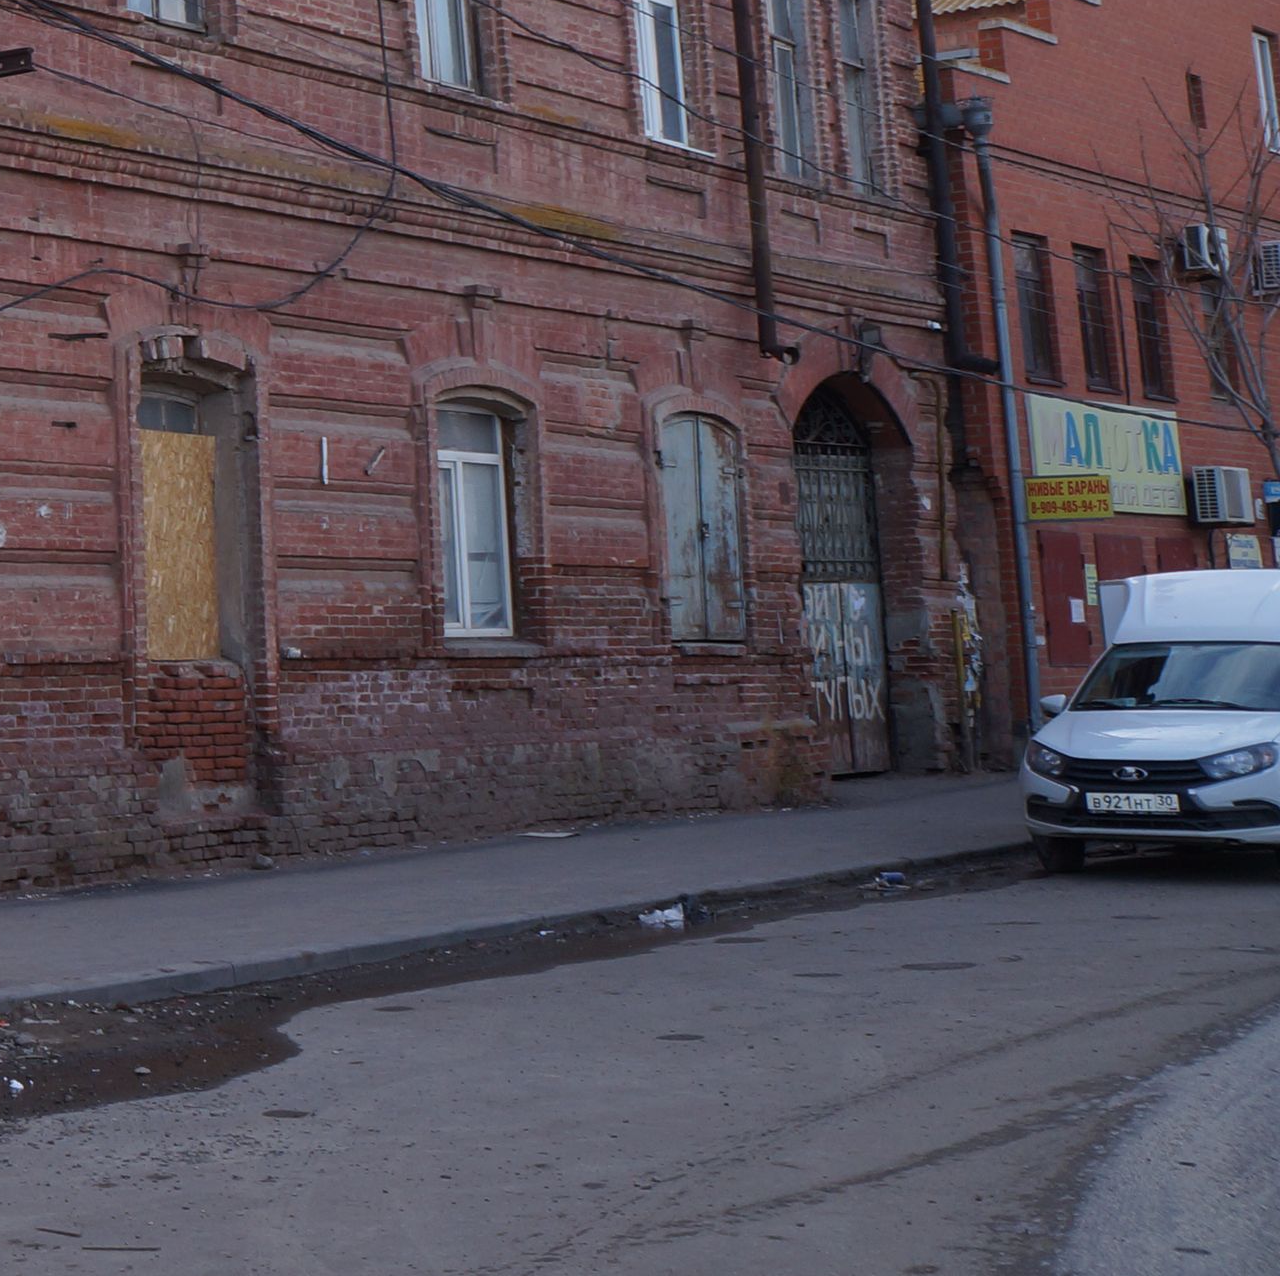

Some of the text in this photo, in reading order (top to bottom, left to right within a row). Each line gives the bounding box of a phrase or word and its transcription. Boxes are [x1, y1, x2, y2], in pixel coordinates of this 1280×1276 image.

[1040, 411, 1180, 474] МАЛЮТКА
[1027, 478, 1110, 496] ЖИВЫЕ БАРАНЫ
[1142, 482, 1184, 509] ДЕТЕЙ
